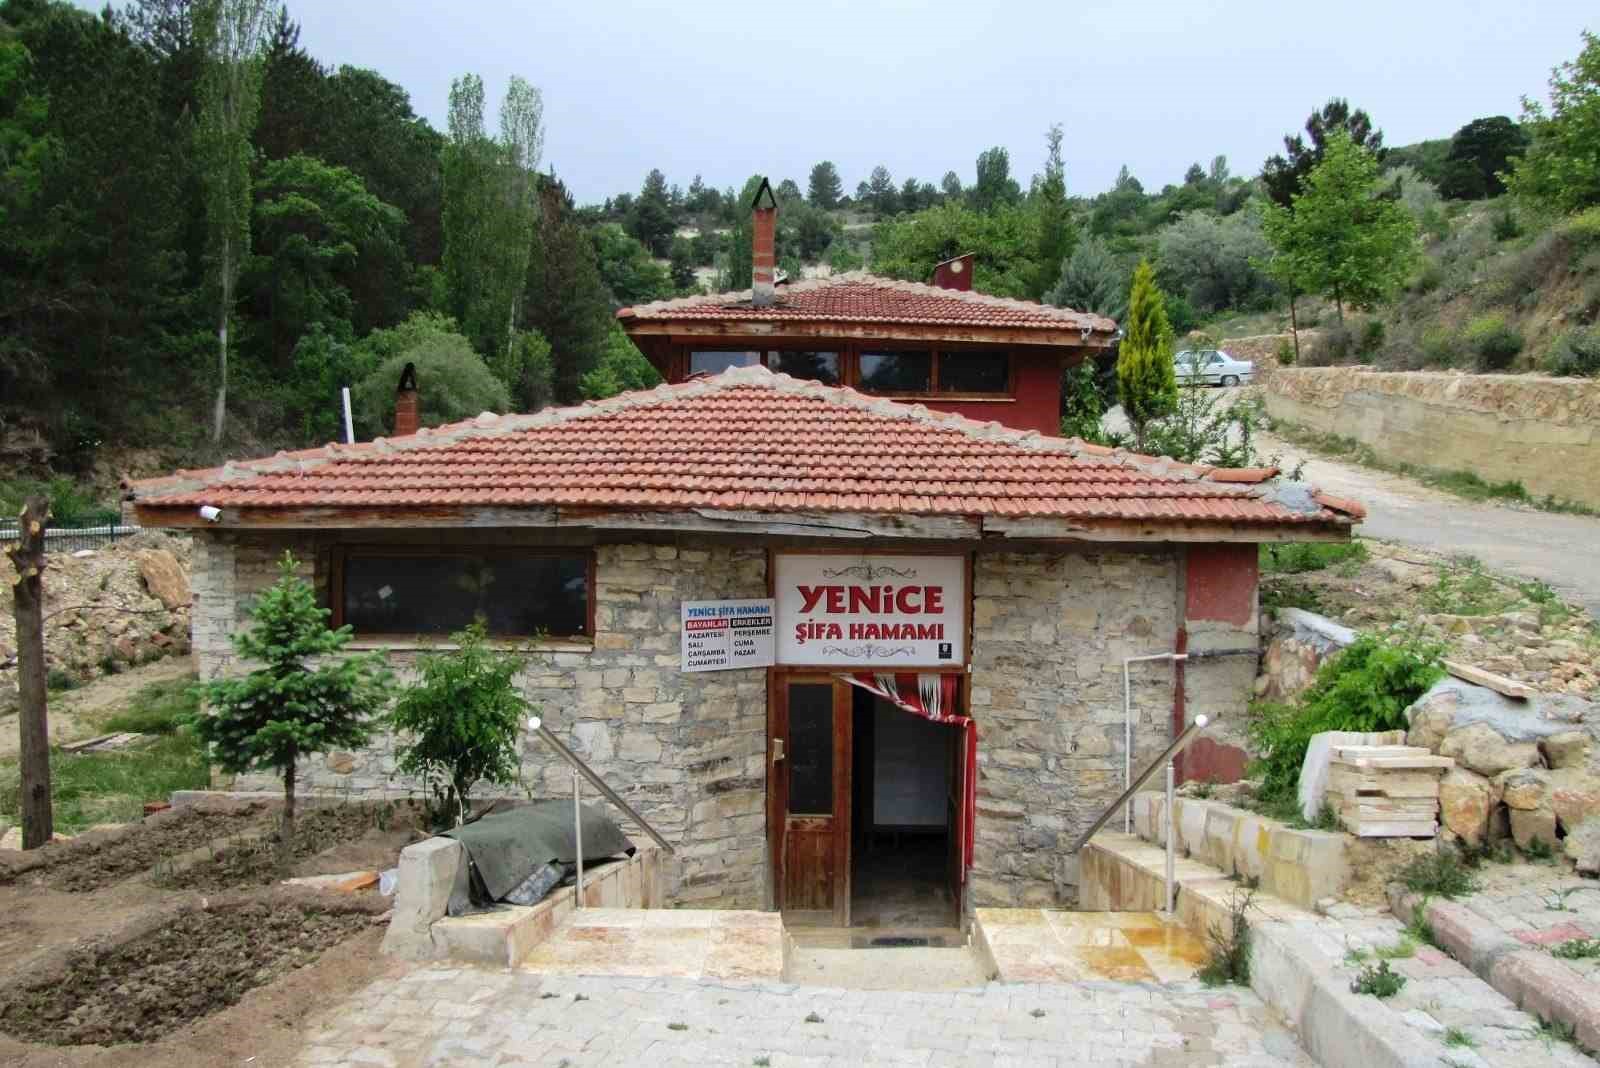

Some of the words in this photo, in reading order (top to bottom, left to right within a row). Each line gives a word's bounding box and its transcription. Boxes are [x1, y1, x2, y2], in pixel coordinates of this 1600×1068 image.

[737, 606, 769, 615] HAMAMI
[795, 619, 843, 644] ŞİFA
[849, 623, 944, 640] HAMAMI
